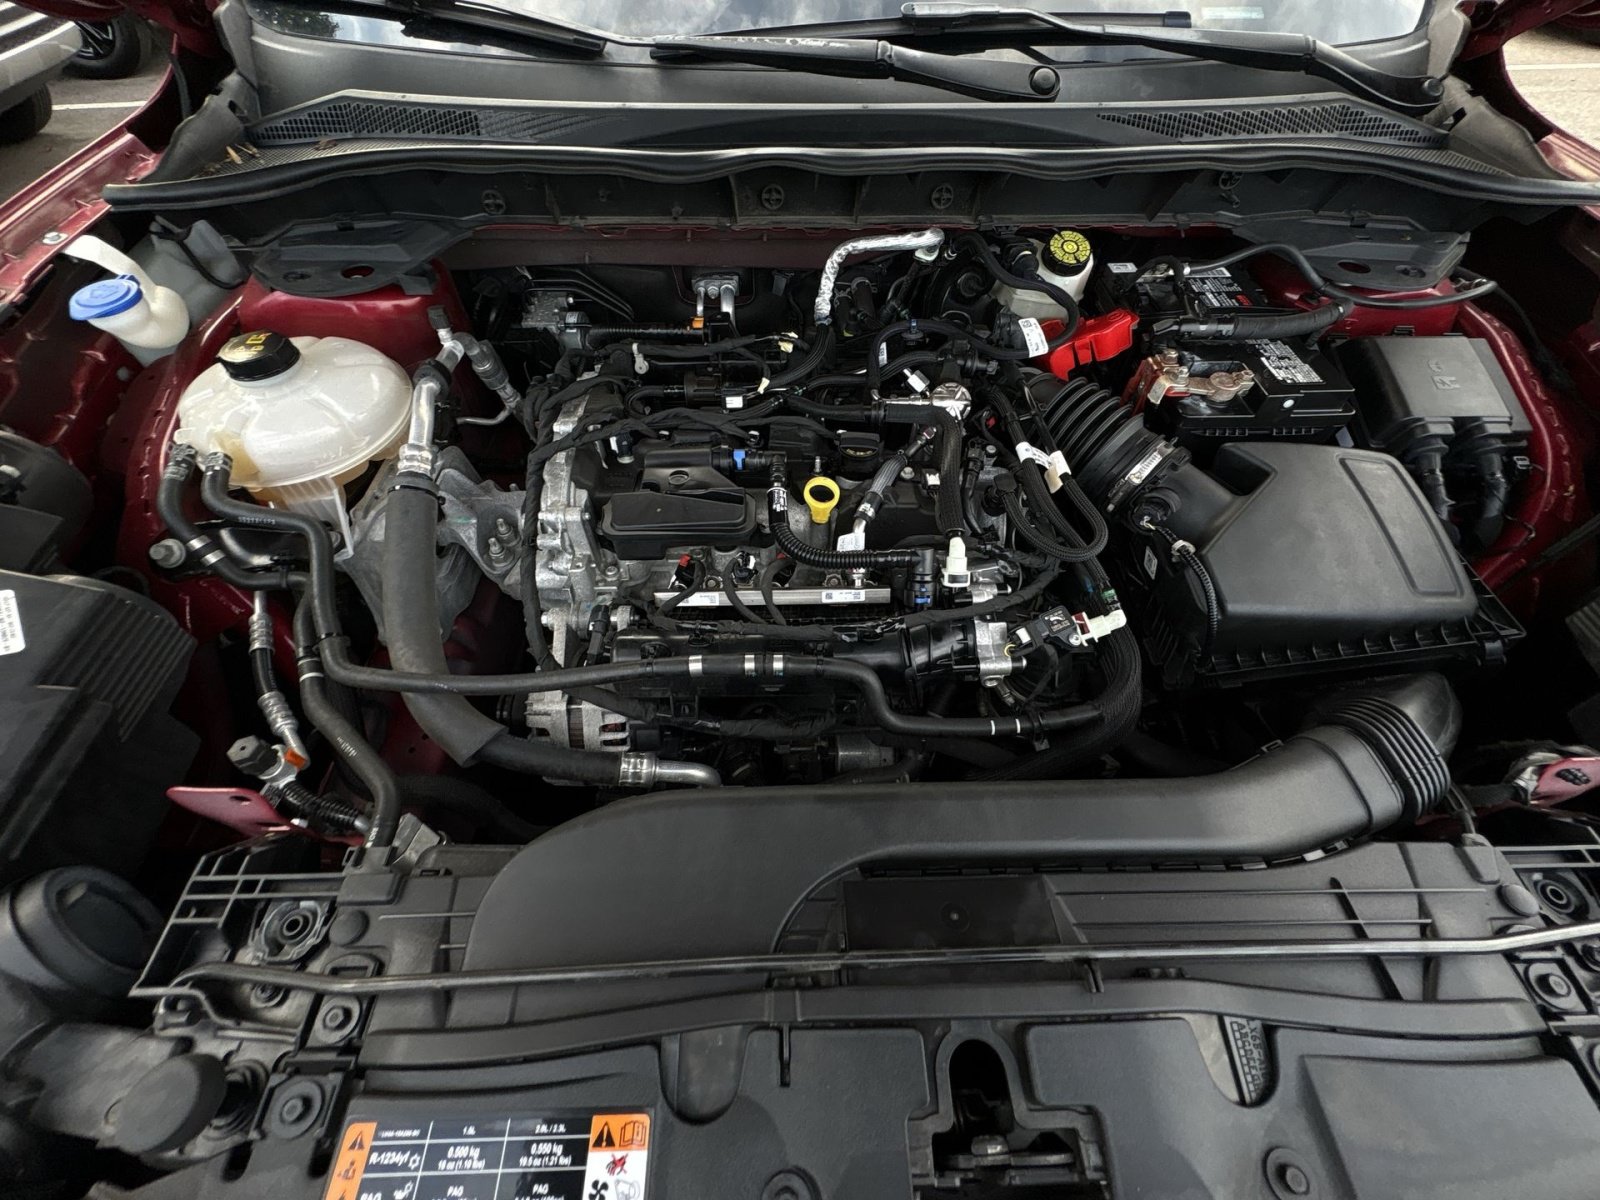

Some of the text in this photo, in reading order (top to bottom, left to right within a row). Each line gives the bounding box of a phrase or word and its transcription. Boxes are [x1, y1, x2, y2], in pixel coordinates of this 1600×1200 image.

[469, 1145, 481, 1161] kg
[552, 1142, 564, 1157] kg
[368, 1150, 411, 1167] R-1234yf
[533, 1157, 542, 1167] oz
